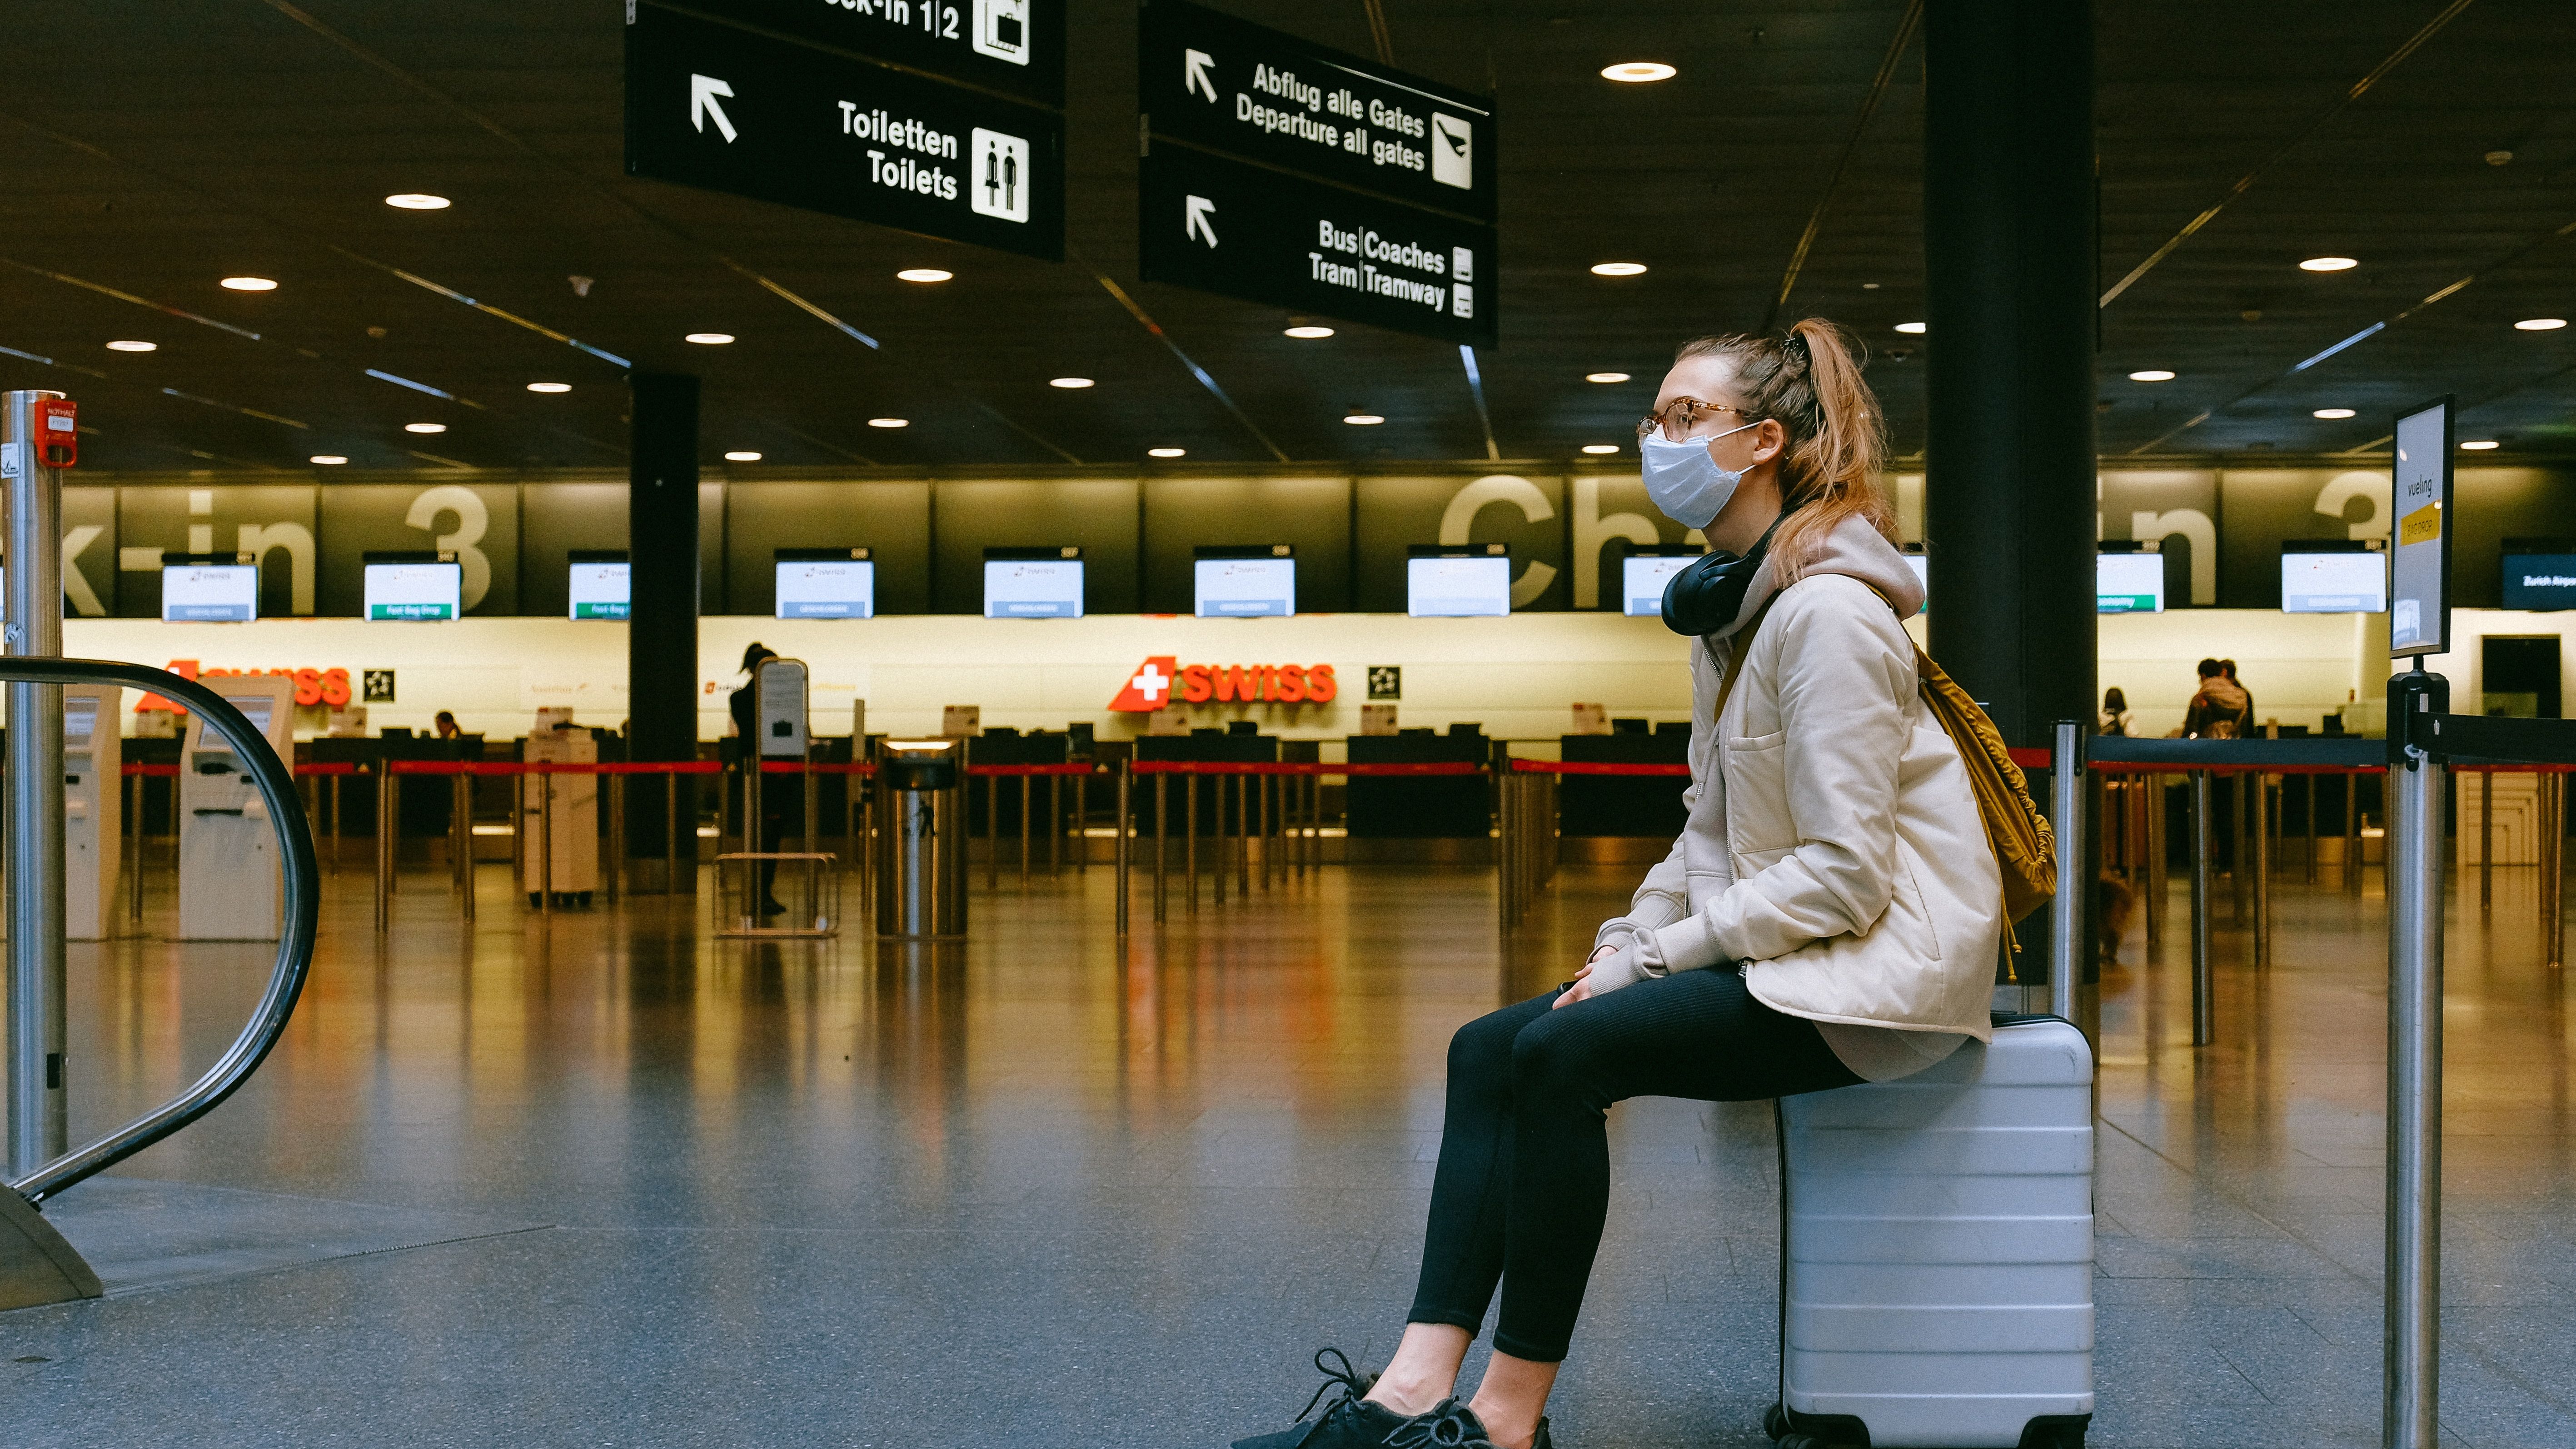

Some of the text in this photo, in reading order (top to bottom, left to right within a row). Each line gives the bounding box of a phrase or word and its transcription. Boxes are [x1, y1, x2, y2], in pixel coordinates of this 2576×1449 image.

[838, 100, 957, 159] Toiletten
[1253, 63, 1425, 138] Abflug alle Gates
[1237, 93, 1425, 171] Departure all gates
[867, 149, 957, 200] Toilets
[2408, 474, 2432, 498] vueling
[405, 485, 491, 611] 3
[1182, 664, 1337, 703] SWISS
